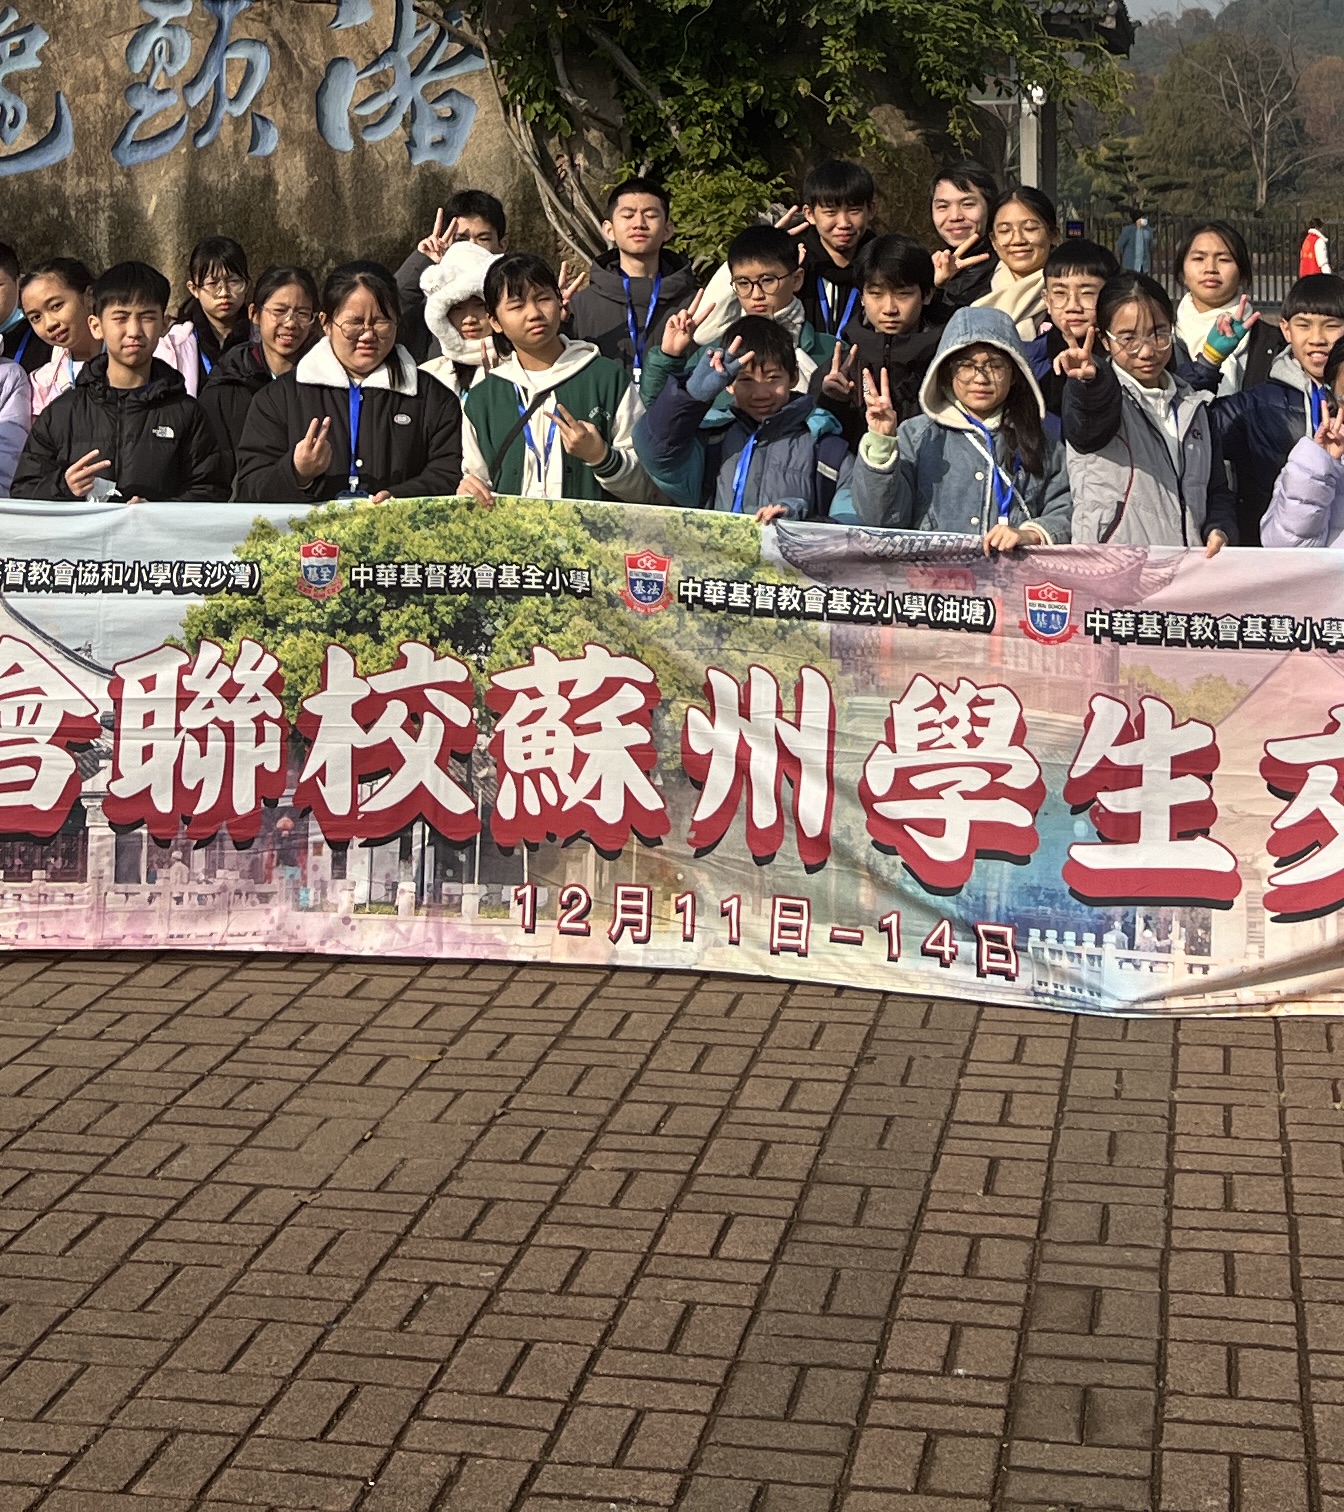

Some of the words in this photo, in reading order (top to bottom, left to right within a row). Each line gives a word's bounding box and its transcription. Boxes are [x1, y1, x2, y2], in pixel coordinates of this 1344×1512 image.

[350, 562, 592, 597] 中華基督教會基全小學
[678, 578, 996, 632] 中華基督教會基法小學(油塘)
